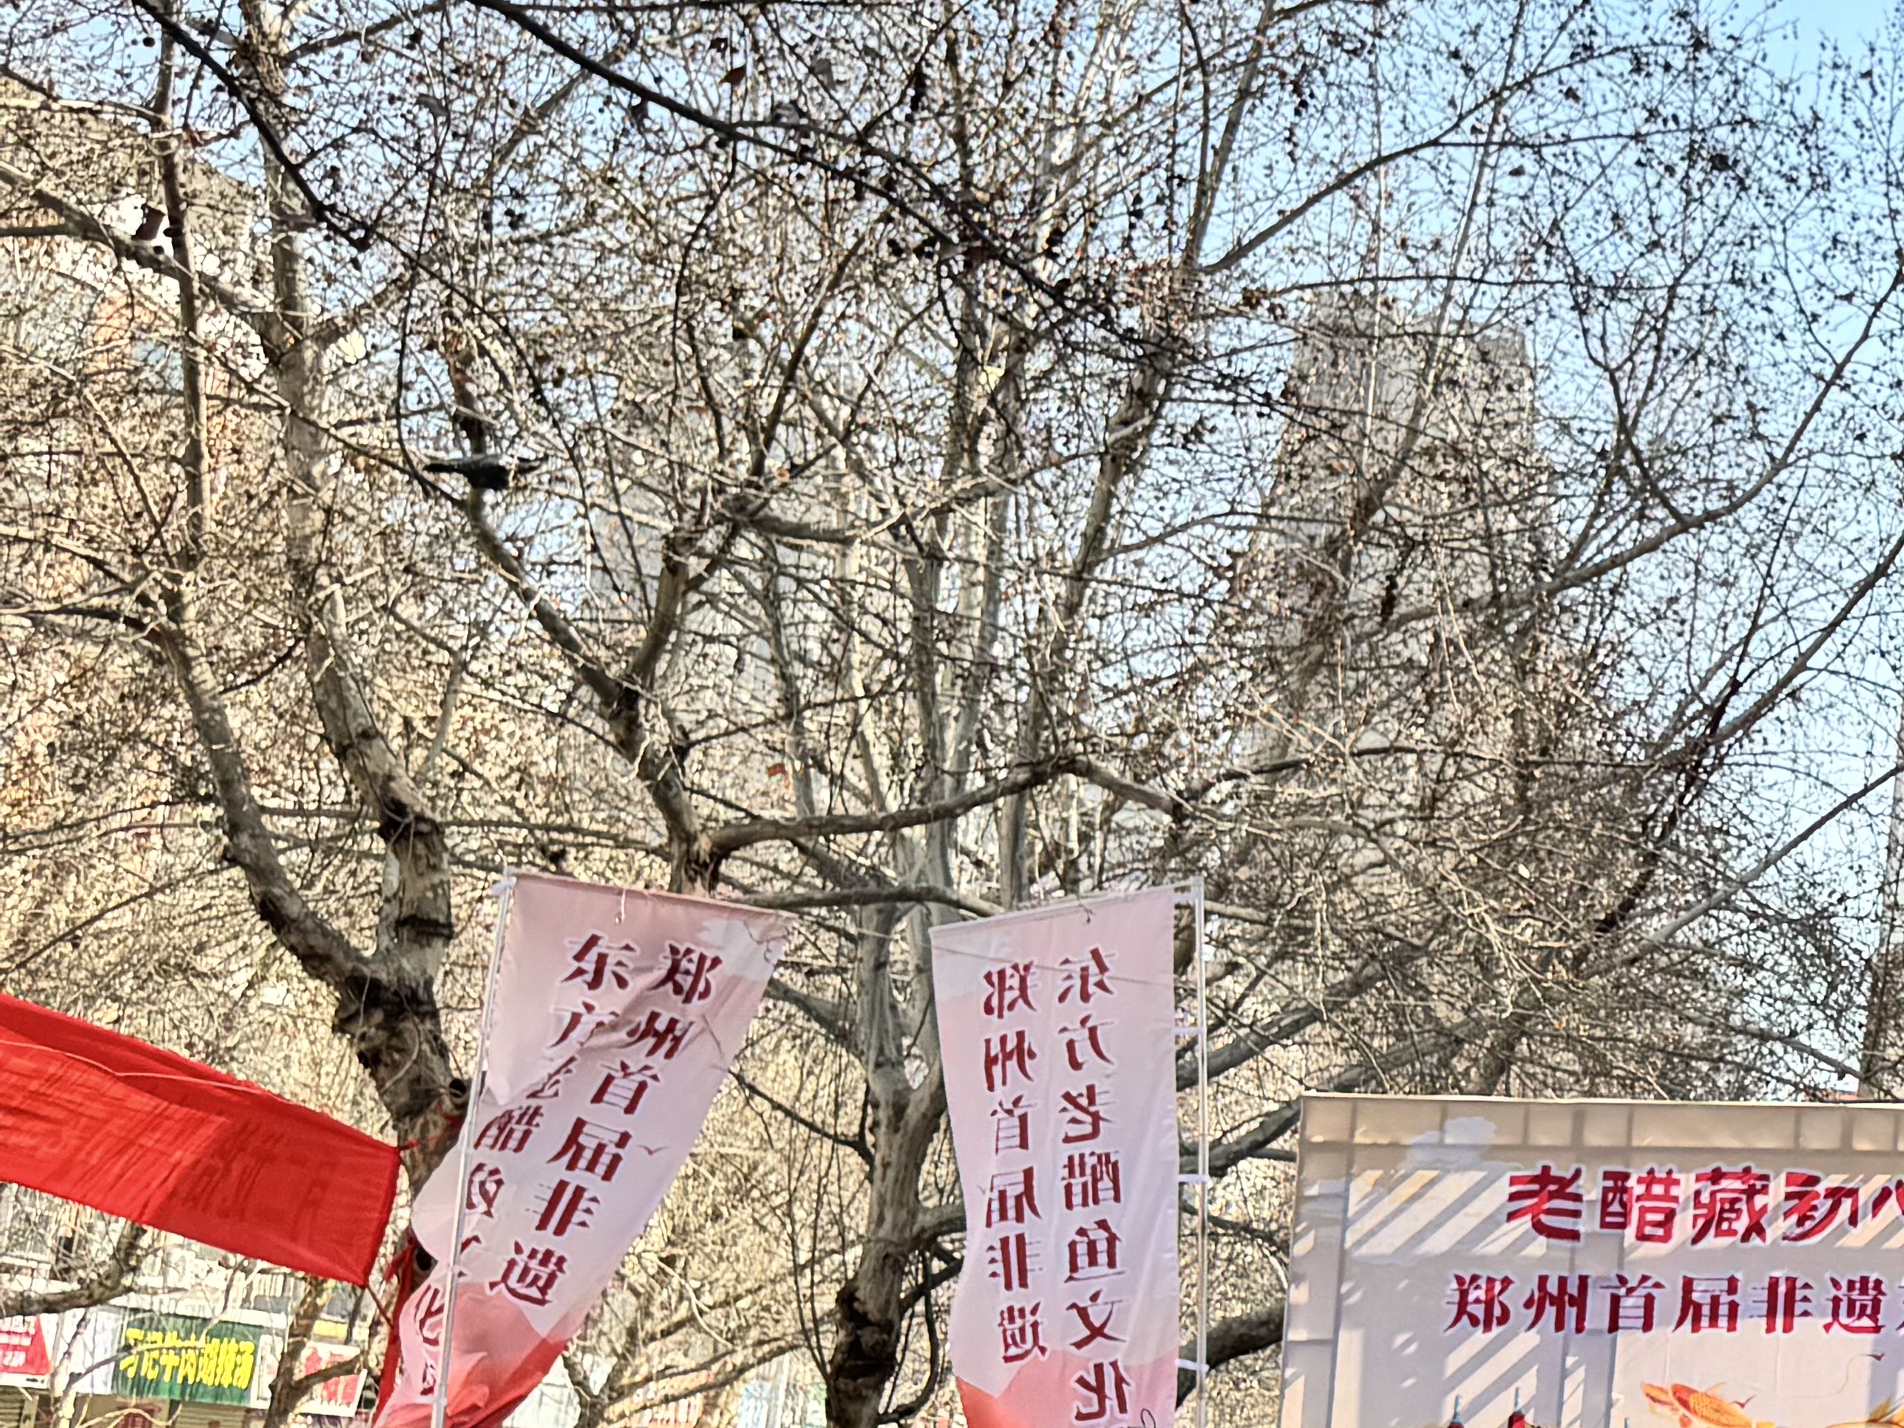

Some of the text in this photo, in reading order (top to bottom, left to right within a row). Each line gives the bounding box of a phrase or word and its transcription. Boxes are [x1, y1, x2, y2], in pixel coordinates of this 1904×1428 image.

[491, 941, 724, 1308] 郑州首届非遗
